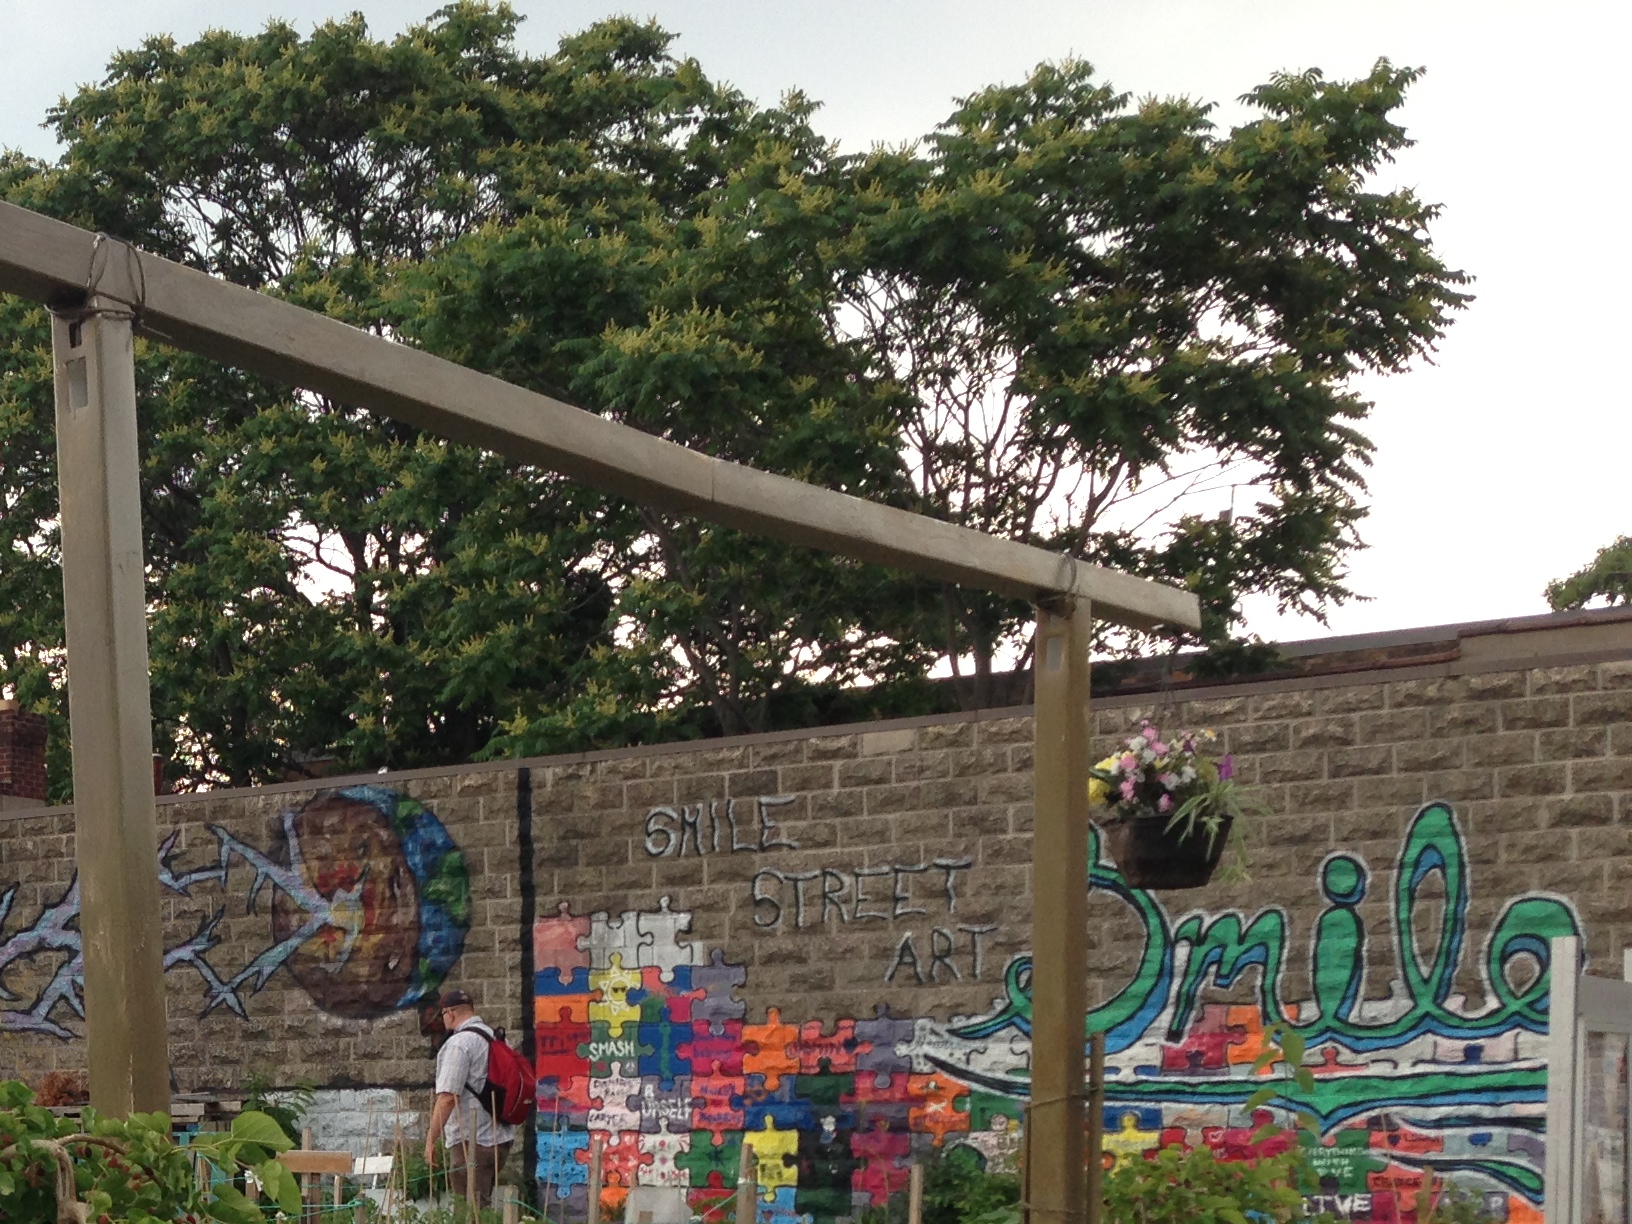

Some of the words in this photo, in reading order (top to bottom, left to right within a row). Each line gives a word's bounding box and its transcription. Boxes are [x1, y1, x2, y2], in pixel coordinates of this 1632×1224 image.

[644, 796, 799, 858] SMILE
[751, 856, 973, 930] STREET
[884, 922, 998, 984] ART
[948, 799, 1590, 1054] Smile
[589, 1040, 635, 1061] SMASH
